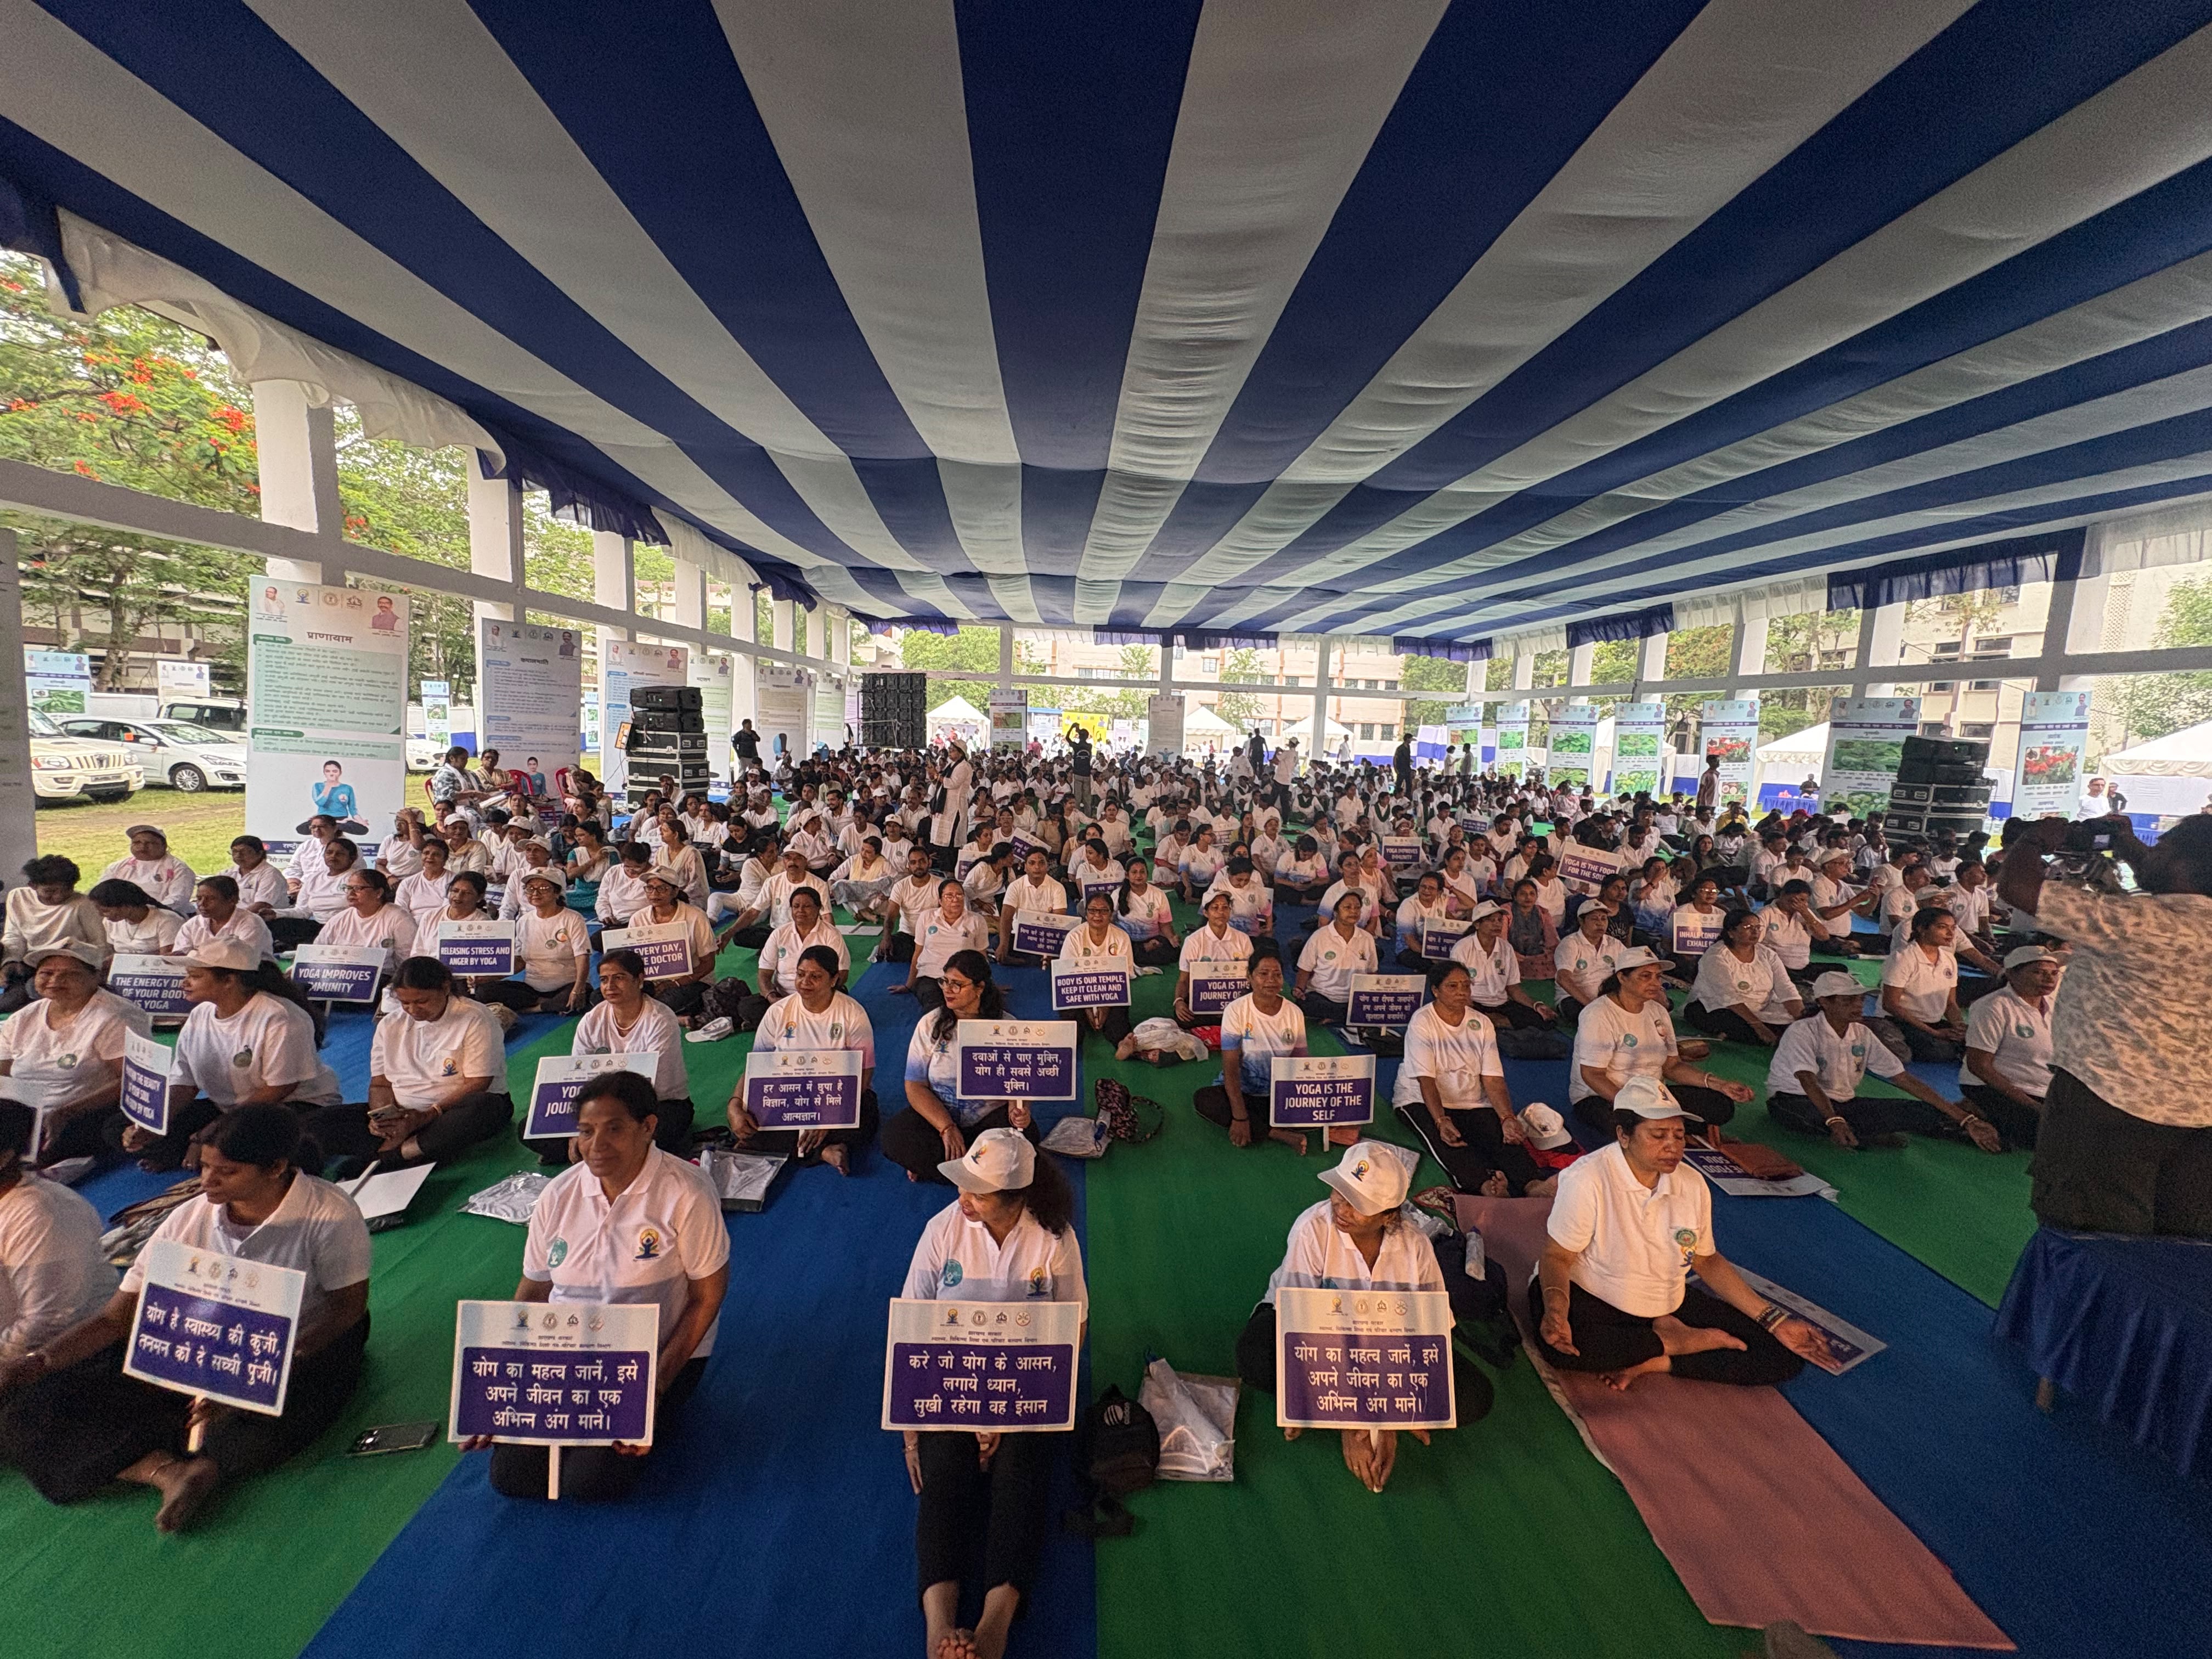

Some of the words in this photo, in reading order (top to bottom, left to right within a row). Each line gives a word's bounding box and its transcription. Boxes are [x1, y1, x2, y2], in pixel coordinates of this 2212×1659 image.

[307, 631, 353, 643] प्राणायाम
[1565, 858, 1579, 866] YOGA
[1588, 864, 1599, 872] THE
[662, 943, 681, 952] DAY,
[651, 953, 683, 964] DOCTOR
[299, 968, 320, 978] YOGA
[322, 969, 371, 980] IMPROVES
[1057, 978, 1075, 986] BODY
[1098, 975, 1125, 983] TEMPLE,
[116, 977, 131, 986] THE
[133, 977, 169, 987] ENERGY
[307, 982, 354, 993] MMUNITY
[1207, 981, 1226, 990] YOGA
[122, 989, 134, 997] OF
[135, 989, 159, 998] YOUR
[1062, 986, 1079, 995] KEEP
[1200, 991, 1231, 1001] JOURNEY
[144, 1000, 169, 1009] YOGA
[972, 1049, 998, 1062] दवाओं
[1003, 1050, 1011, 1062] से
[1017, 1053, 1031, 1064] पाए
[1037, 1050, 1062, 1065] मुक्ति,
[975, 1063, 991, 1076] योग
[996, 1063, 1005, 1076] ही
[1010, 1064, 1031, 1076] सबसे
[1036, 1064, 1059, 1077] अच्छी
[764, 1084, 774, 1093] हर
[778, 1084, 801, 1092] आसन
[817, 1083, 832, 1094] छुपा
[837, 1079, 843, 1092] है
[1004, 1080, 1029, 1093] युक्ति।
[1296, 1084, 1322, 1094] YOGA
[1324, 1084, 1333, 1094] IS
[1335, 1083, 1353, 1093] THE
[763, 1096, 789, 1108] विज्ञान,
[794, 1095, 809, 1107] योग
[814, 1094, 821, 1106] से
[826, 1093, 842, 1105] मिले
[1285, 1097, 1328, 1110] JOURNEY
[1330, 1097, 1343, 1107] OF
[1345, 1095, 1362, 1106] THE
[782, 1113, 820, 1121] आत्मज्ञान।
[1313, 1110, 1335, 1121] SELF
[146, 1302, 166, 1325] योग
[170, 1307, 180, 1330] है
[184, 1317, 223, 1341] स्वास्थ्य
[228, 1323, 245, 1346] की
[250, 1329, 281, 1358] कुंजी,
[139, 1333, 172, 1358] तनमन
[174, 1341, 191, 1363] को
[196, 1345, 206, 1367] दे
[211, 1352, 242, 1375] सच्ची
[1294, 1341, 1317, 1362] योग
[1325, 1347, 1341, 1363] का
[1349, 1348, 1381, 1364] महत्व
[1388, 1343, 1415, 1367] जानें,
[1423, 1343, 1439, 1367] इसे
[909, 1350, 930, 1370] करे
[938, 1351, 955, 1369] जो
[962, 1351, 986, 1371] योग
[995, 1352, 1008, 1371] के
[1015, 1356, 1057, 1373] आसन,
[473, 1356, 498, 1378] योग
[506, 1363, 523, 1378] का
[531, 1364, 566, 1381] महत्व
[575, 1359, 608, 1383] जानें,
[618, 1359, 639, 1384] इसे
[943, 1373, 978, 1392] लगाये
[988, 1378, 1022, 1395] ध्यान,
[1308, 1366, 1338, 1387] अपने
[1346, 1367, 1380, 1388] जीवन
[1387, 1373, 1402, 1388] का
[1409, 1373, 1429, 1391] एक
[486, 1381, 518, 1403] अपने
[527, 1382, 562, 1405] जीवन
[572, 1390, 590, 1405] का
[599, 1390, 622, 1409] एक
[914, 1394, 943, 1418] सुखी
[951, 1394, 981, 1415] रहेगा
[989, 1400, 1008, 1415] वह
[1015, 1395, 1047, 1417] इंसान
[1365, 1392, 1387, 1413] अंग
[1395, 1392, 1421, 1413] माने।
[545, 1408, 569, 1430] अंग
[579, 1409, 610, 1431] माने।
